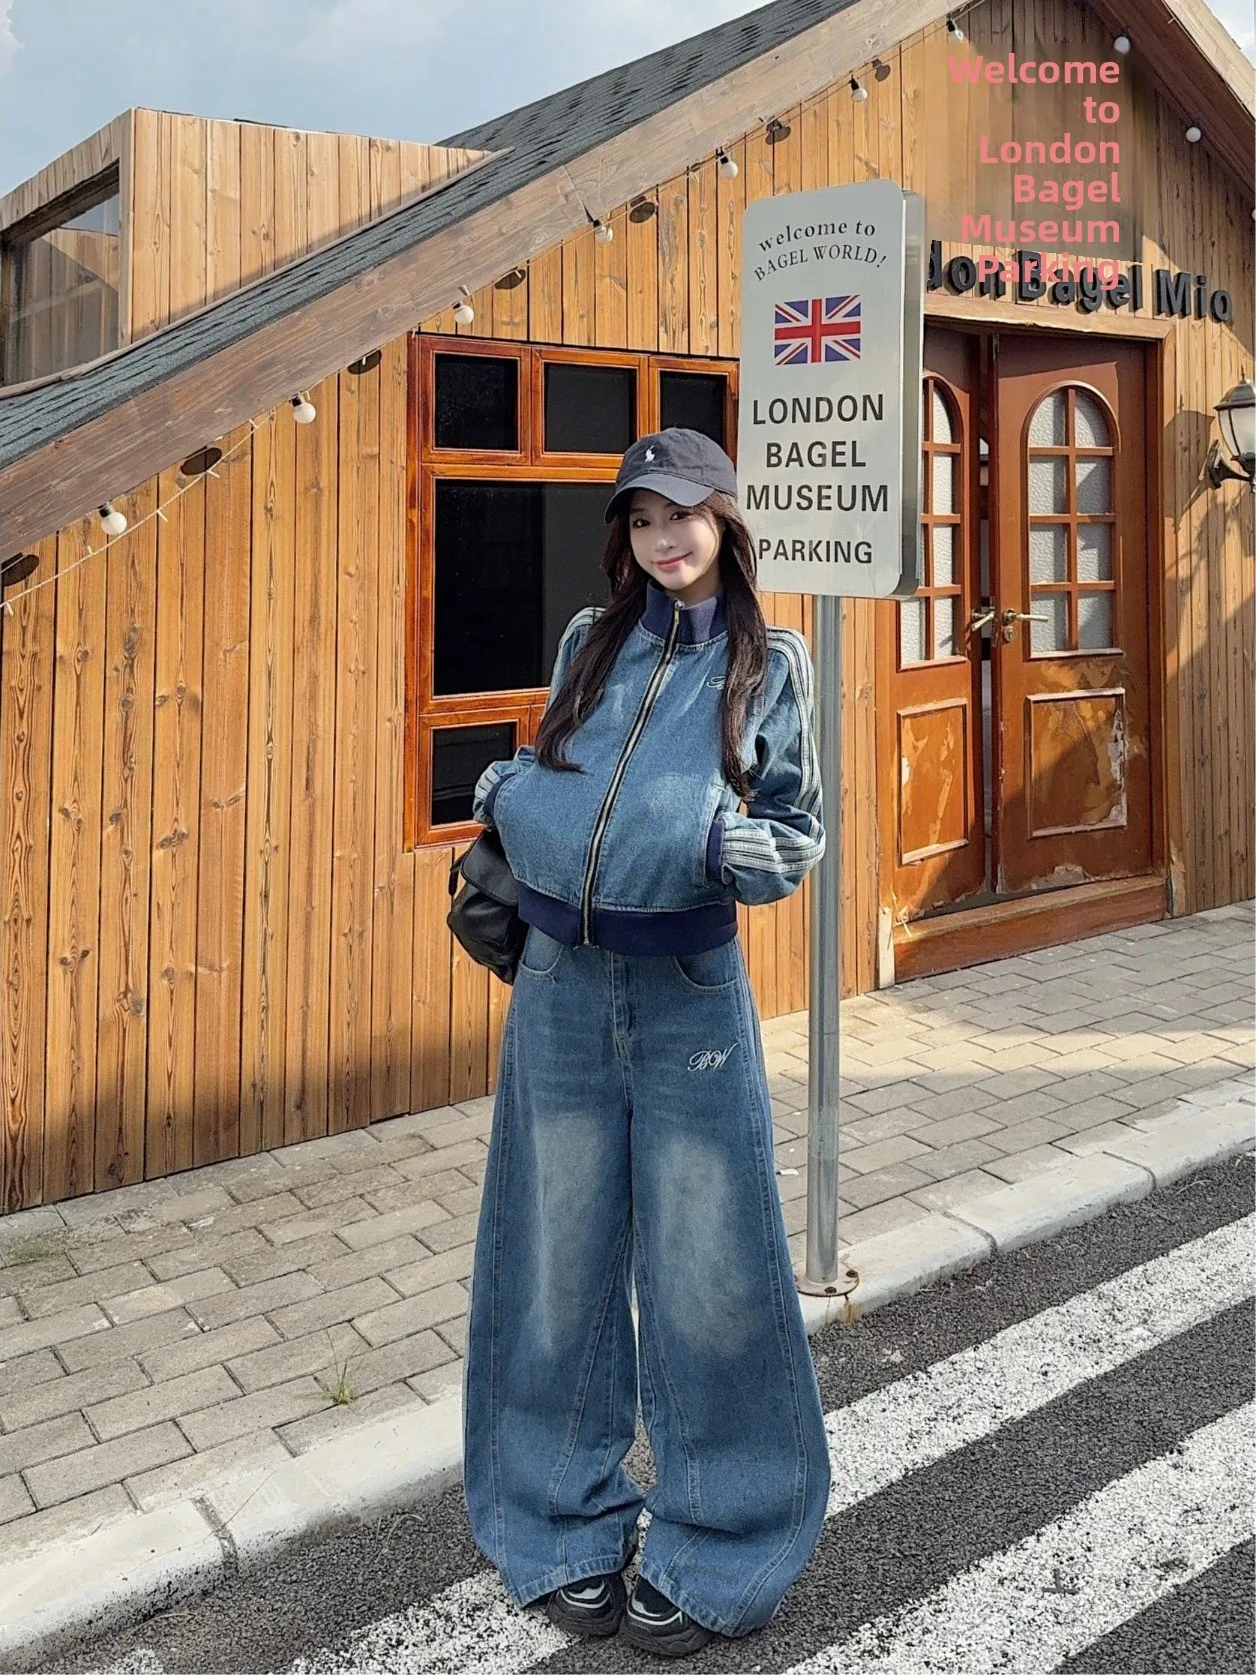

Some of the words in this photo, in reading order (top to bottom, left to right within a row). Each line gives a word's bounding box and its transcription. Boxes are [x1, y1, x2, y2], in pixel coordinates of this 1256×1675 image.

[758, 220, 848, 253] welcome
[855, 220, 876, 237] to
[753, 249, 809, 282] BAGEL
[813, 244, 888, 269] WORLD!
[1017, 250, 1143, 315] Bagel
[753, 394, 884, 425] LONDON
[766, 440, 867, 468] BAGEL
[746, 484, 888, 512] MUSEUM
[758, 538, 873, 564] PARKING
